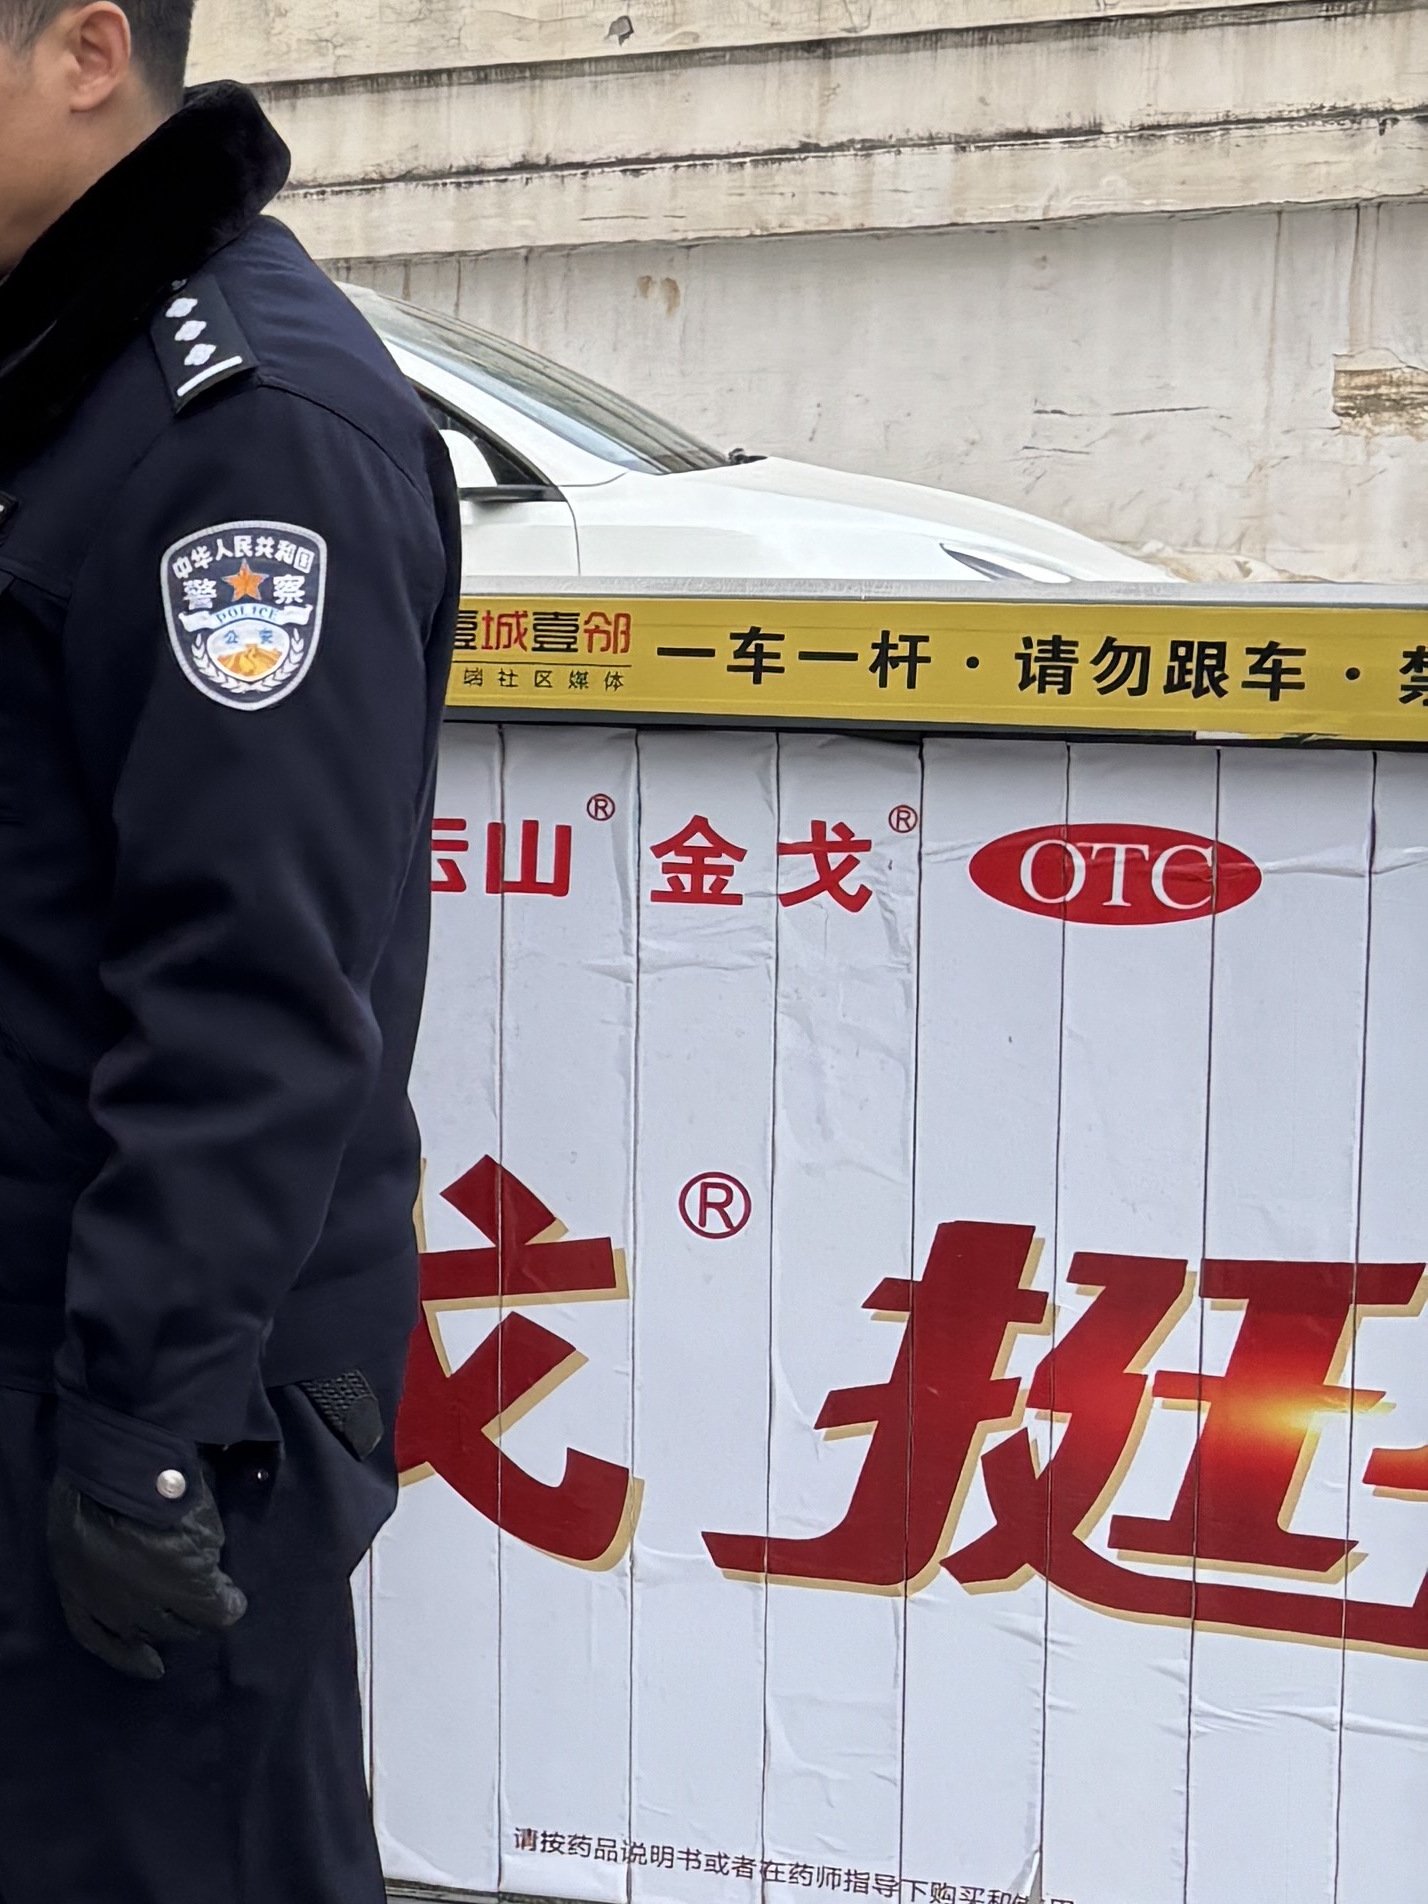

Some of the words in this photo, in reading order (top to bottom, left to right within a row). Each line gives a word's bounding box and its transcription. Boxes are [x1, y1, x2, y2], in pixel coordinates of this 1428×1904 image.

[172, 535, 315, 580] 中华人民共和国
[216, 605, 278, 624] POLICE
[1020, 839, 1216, 909] OTC
